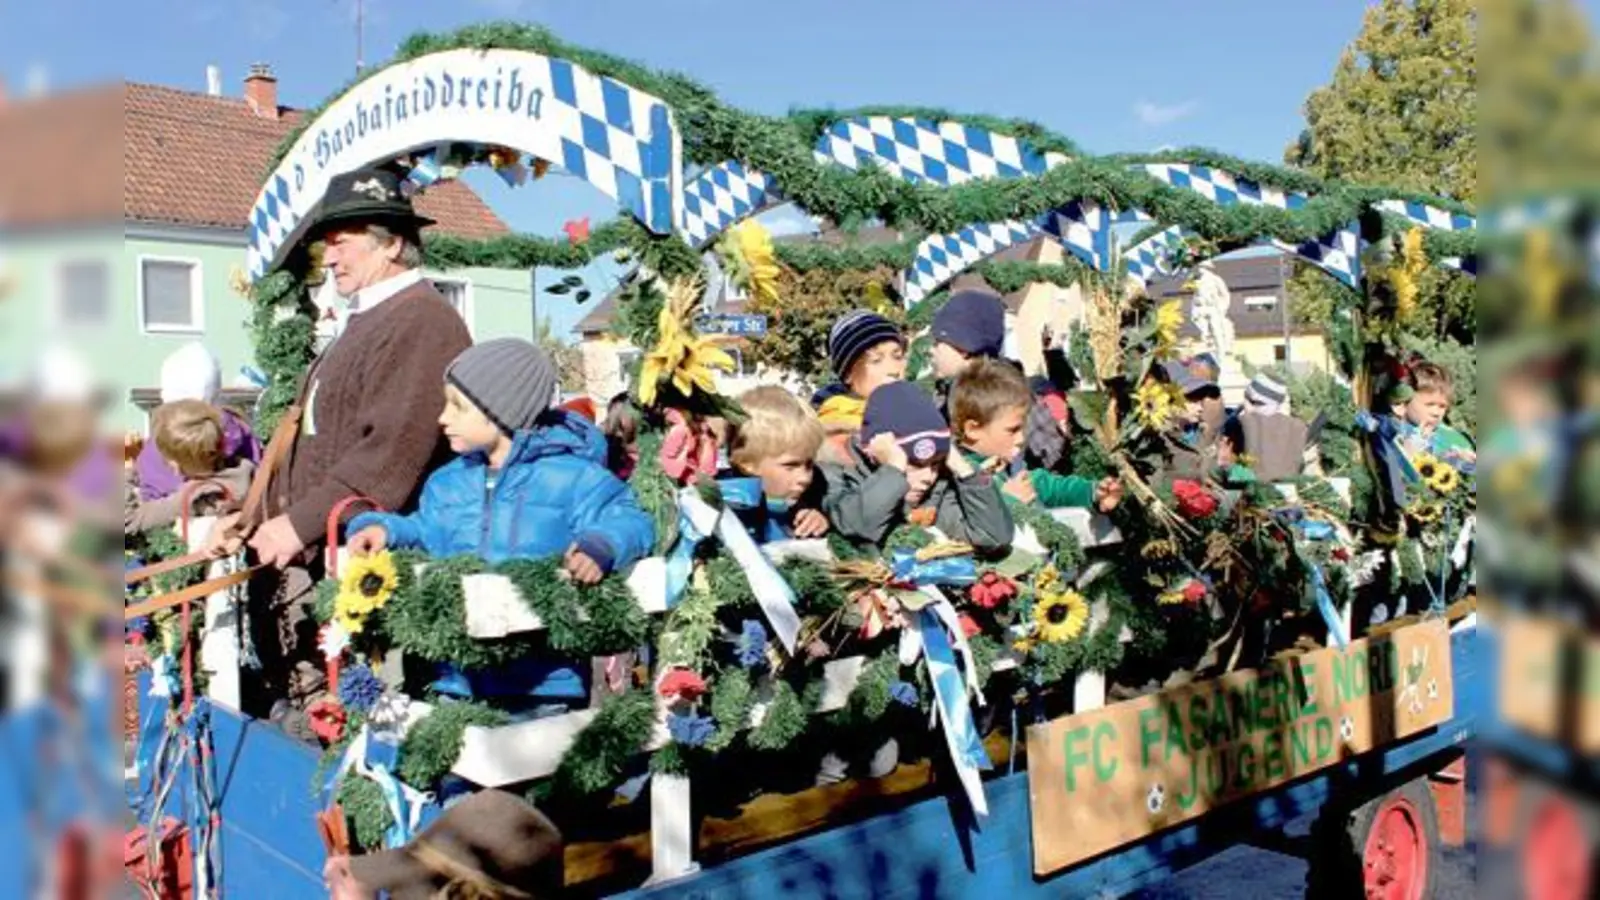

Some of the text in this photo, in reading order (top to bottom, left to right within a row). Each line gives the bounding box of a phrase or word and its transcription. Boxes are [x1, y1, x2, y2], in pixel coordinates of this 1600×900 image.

[1063, 640, 1399, 792] FC FASANERIE NORD
[1176, 715, 1334, 810] JUGEND
